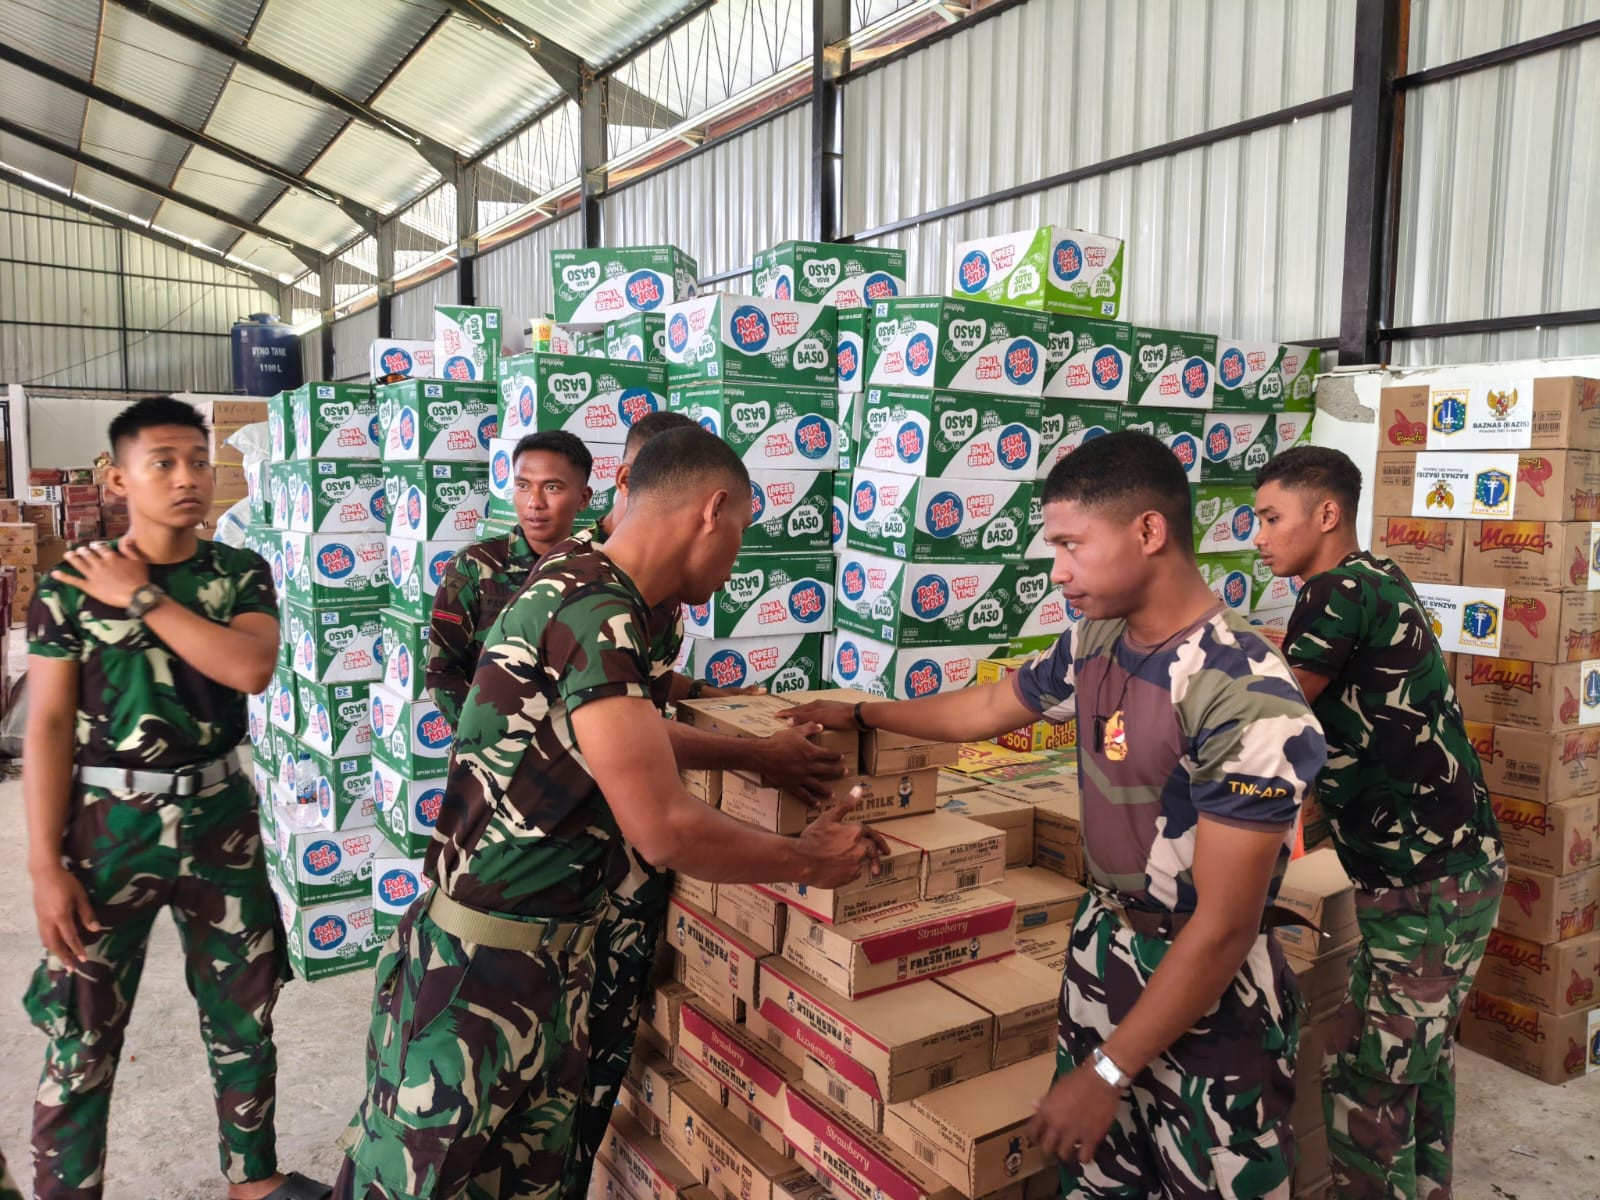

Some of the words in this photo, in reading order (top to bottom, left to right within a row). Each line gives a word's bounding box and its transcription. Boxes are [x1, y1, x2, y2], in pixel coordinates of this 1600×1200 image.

[1058, 248, 1074, 263] POP
[808, 263, 836, 276] BASO
[964, 256, 981, 276] POP
[1060, 256, 1079, 273] MIE
[567, 267, 596, 281] BASO
[967, 264, 986, 287] MIE
[1014, 274, 1032, 284] SOTO
[630, 276, 654, 296] MIE
[1096, 280, 1110, 288] SOTO
[637, 286, 660, 305] POP
[1104, 304, 1113, 314] 24
[736, 314, 760, 332] POP
[770, 312, 800, 326] LAPEER
[742, 325, 766, 344] MIE
[776, 324, 798, 336] TIME
[954, 325, 982, 339] BASO
[385, 352, 402, 365] POP
[798, 352, 824, 364] BASO
[978, 356, 999, 368] TIME
[1008, 348, 1030, 365] MIE
[1096, 355, 1116, 372] MIE
[1142, 349, 1164, 362] BASO
[1014, 360, 1034, 378] POP
[1100, 366, 1120, 384] POP
[1185, 365, 1202, 382] MIE
[319, 388, 331, 396] 24
[428, 386, 440, 394] 24
[554, 378, 587, 392] BASO
[1189, 376, 1206, 392] POP
[324, 406, 350, 416] BASO
[432, 406, 458, 416] BASO
[586, 404, 612, 416] TIME
[622, 394, 647, 414] MIE
[736, 406, 766, 422] BASO
[945, 415, 972, 430] BASO
[766, 433, 788, 446] TIME
[798, 422, 822, 442] MIE
[1002, 432, 1024, 448] MIE
[1210, 430, 1226, 446] POP
[806, 432, 828, 450] POP
[970, 441, 992, 455] TIME
[1212, 440, 1229, 456] MIE
[1007, 442, 1028, 462] POP
[1246, 453, 1266, 466] BASO
[322, 464, 333, 472] 24
[434, 467, 446, 476] 24
[326, 480, 351, 490] BASO
[440, 486, 466, 496] BASO
[771, 494, 793, 507] TIME
[966, 494, 995, 510] LAPEER
[932, 500, 954, 520] POP
[970, 505, 992, 519] TIME
[792, 517, 818, 531] BASO
[884, 522, 903, 534] BASO
[934, 510, 960, 531] MIE
[986, 528, 1014, 544] BASO
[1379, 524, 1454, 550] Maya
[1473, 528, 1553, 554] Maya
[322, 550, 344, 565] POP
[896, 546, 905, 556] 24
[328, 556, 352, 574] MIE
[730, 576, 760, 590] BASO
[918, 582, 938, 600] POP
[952, 576, 978, 593] LAPEER
[1020, 580, 1044, 594] BASO
[792, 587, 816, 605] MIE
[954, 586, 976, 600] TIME
[760, 600, 782, 614] TIME
[800, 597, 822, 616] POP
[874, 604, 892, 617] BASO
[921, 593, 944, 613] MIE
[1430, 601, 1456, 610] BAZNAS
[324, 614, 336, 622] 24
[972, 609, 999, 624] BASO
[328, 630, 354, 642] BASO
[748, 647, 778, 664] LAPEER
[711, 655, 735, 678] POP
[752, 660, 777, 672] TIME
[944, 658, 970, 674] LAPEER
[717, 667, 743, 687] MIE
[911, 665, 932, 684] POP
[948, 668, 968, 684] TIME
[1464, 663, 1542, 690] Maya
[336, 688, 350, 696] 24
[776, 678, 805, 692] BASO
[914, 678, 938, 696] MIE
[342, 702, 368, 716] BASO
[423, 716, 446, 736] POP
[1046, 730, 1076, 750] Gelas
[348, 776, 371, 788] BASO
[866, 796, 895, 810] MILK
[308, 845, 330, 863] POP
[314, 854, 338, 870] MIE
[384, 874, 406, 894] POP
[391, 884, 415, 900] MIE
[314, 920, 336, 938] POP
[320, 928, 343, 945] MIE
[688, 924, 704, 944] MILK
[918, 920, 968, 940] Strawberry
[705, 936, 728, 962] FRESH
[910, 953, 942, 970] FRESH
[944, 946, 968, 960] MILK
[796, 1000, 815, 1021] MILK
[816, 1014, 842, 1041] FRESH
[1470, 1000, 1546, 1040] Maya
[712, 1031, 744, 1068] Strawberry
[796, 1028, 836, 1068] Strawberry
[710, 1054, 730, 1078] FRESH
[730, 1071, 746, 1092] MILK
[696, 1124, 715, 1151] MILK
[826, 1124, 870, 1172] Strawberry
[714, 1146, 740, 1176] FRESH
[823, 1150, 849, 1179] FRESH
[850, 1173, 872, 1198] MILK
